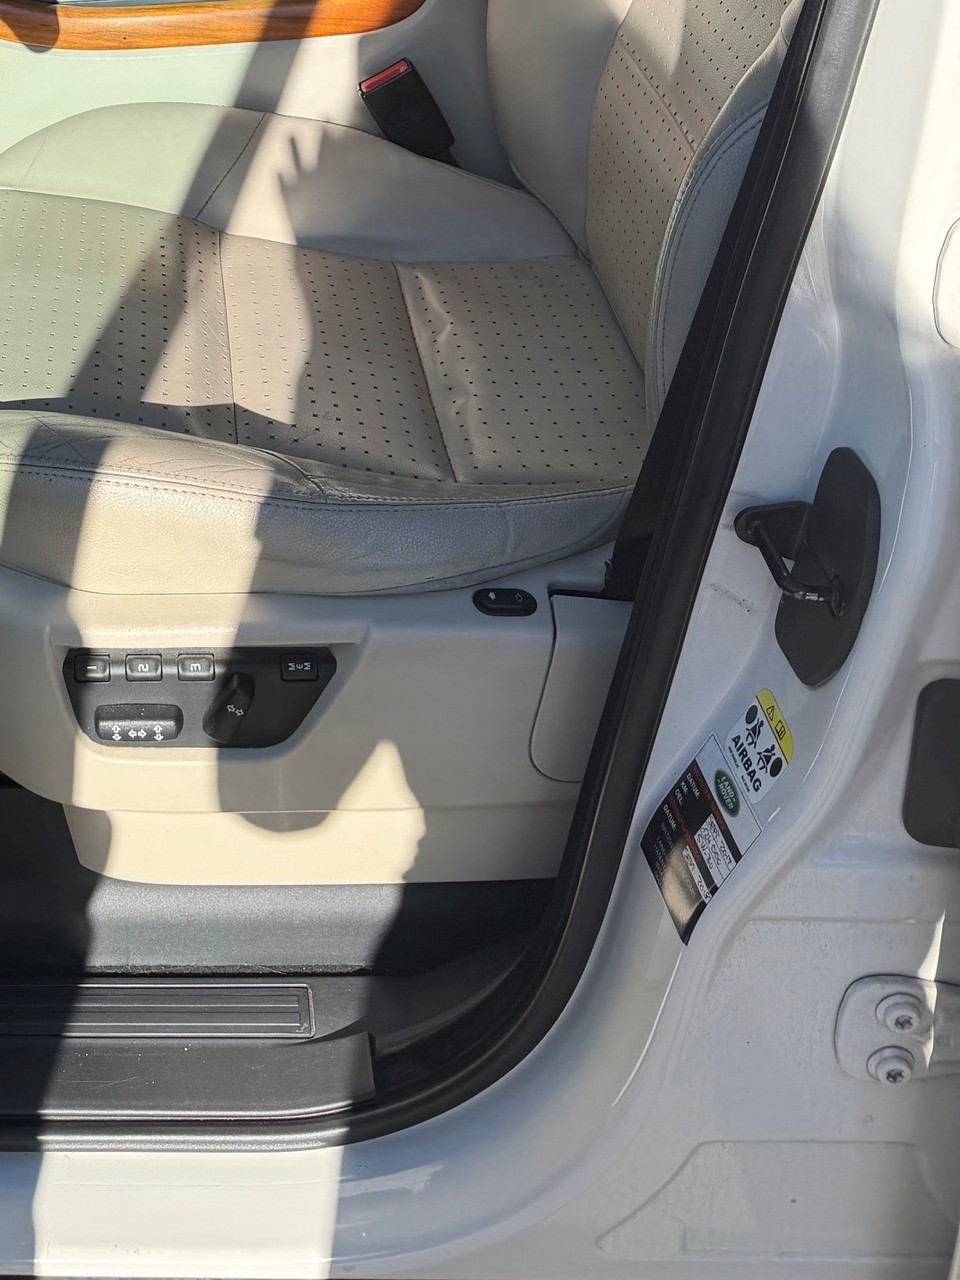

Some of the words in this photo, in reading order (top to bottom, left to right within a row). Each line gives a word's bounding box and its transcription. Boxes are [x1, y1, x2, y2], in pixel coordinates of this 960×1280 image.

[138, 662, 149, 673] 2
[190, 662, 202, 672] 3
[731, 734, 762, 793] AIRBAG
[686, 772, 701, 800] DATUM:
[718, 783, 734, 809] ROVER
[720, 775, 735, 798] LAND
[662, 803, 677, 831] DATUM:
